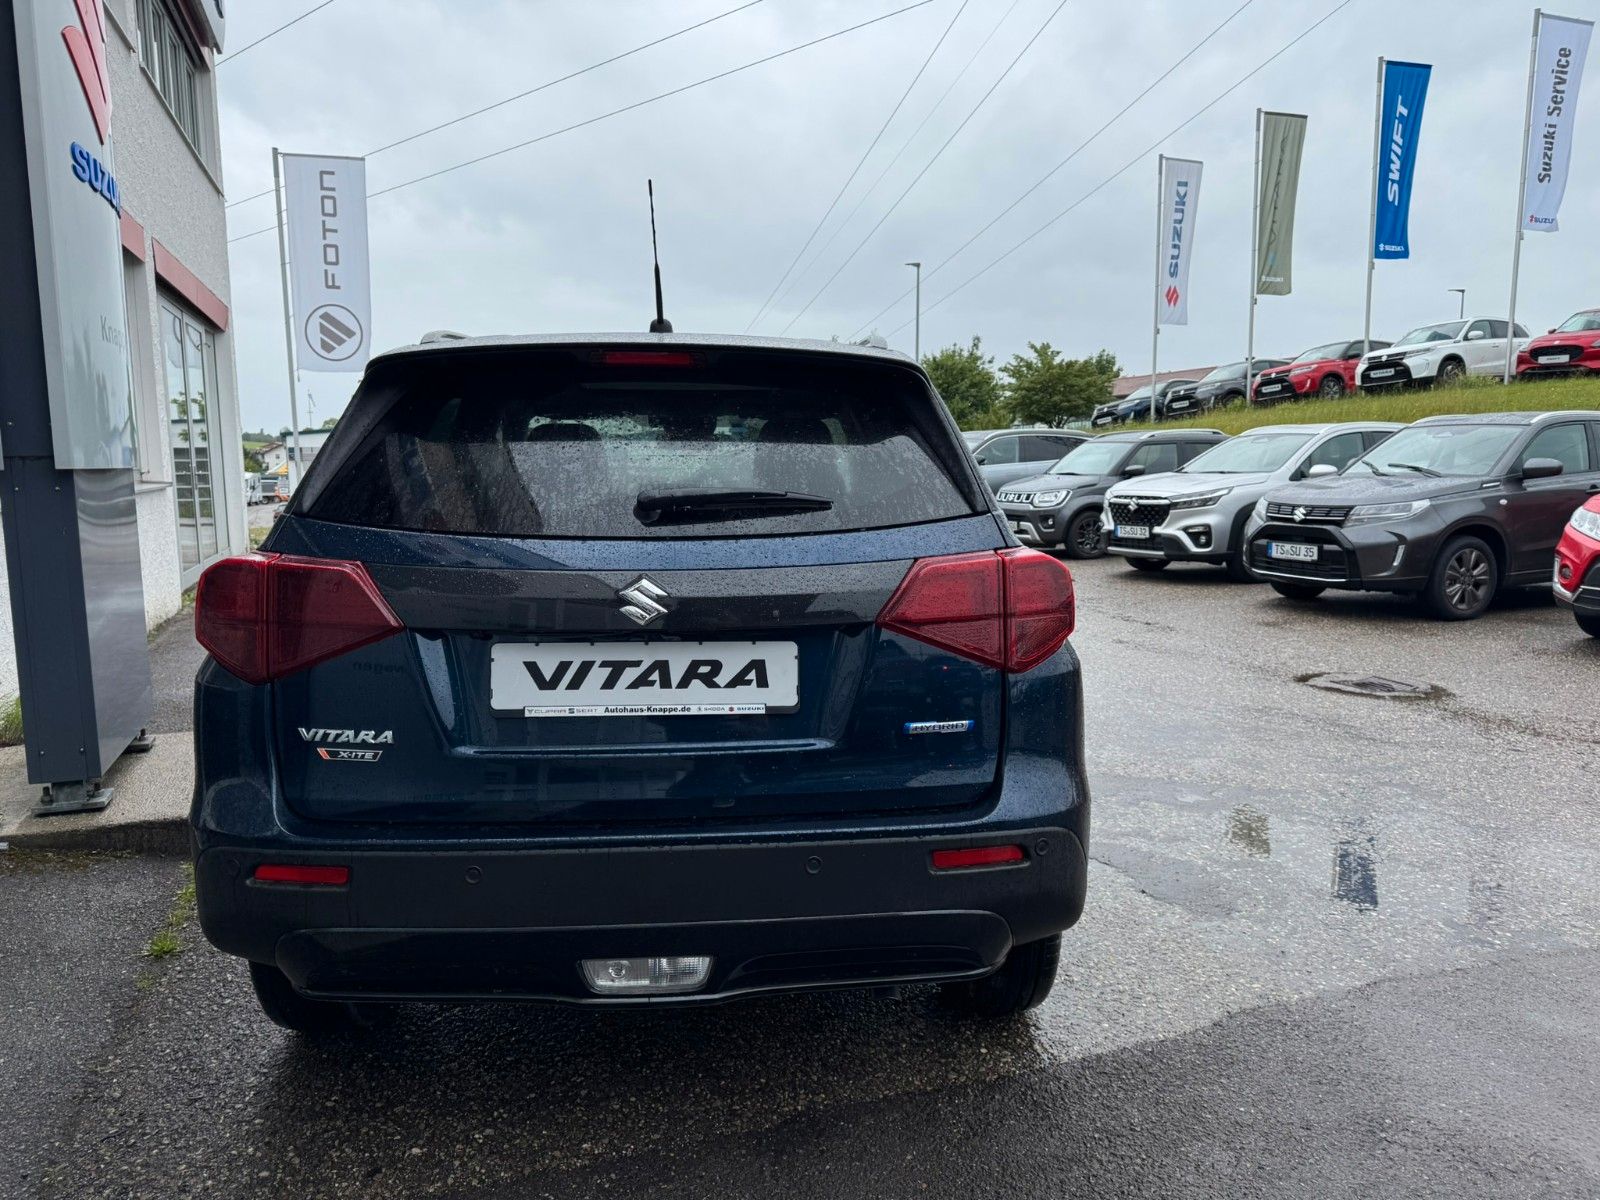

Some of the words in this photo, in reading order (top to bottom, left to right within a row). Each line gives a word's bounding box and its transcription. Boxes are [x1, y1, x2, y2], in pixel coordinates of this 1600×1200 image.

[1547, 47, 1572, 117] Service
[1387, 94, 1409, 207] SWIFT
[1537, 123, 1558, 184] Suzuki
[1169, 181, 1189, 279] SUZUKI
[1303, 546, 1315, 558] 35
[522, 659, 769, 691] VITARA
[604, 706, 692, 714] Autohaus-Knappe.de
[298, 727, 394, 744] VITARA
[911, 722, 965, 732] HYBRID
[338, 751, 375, 759] X-ITE
